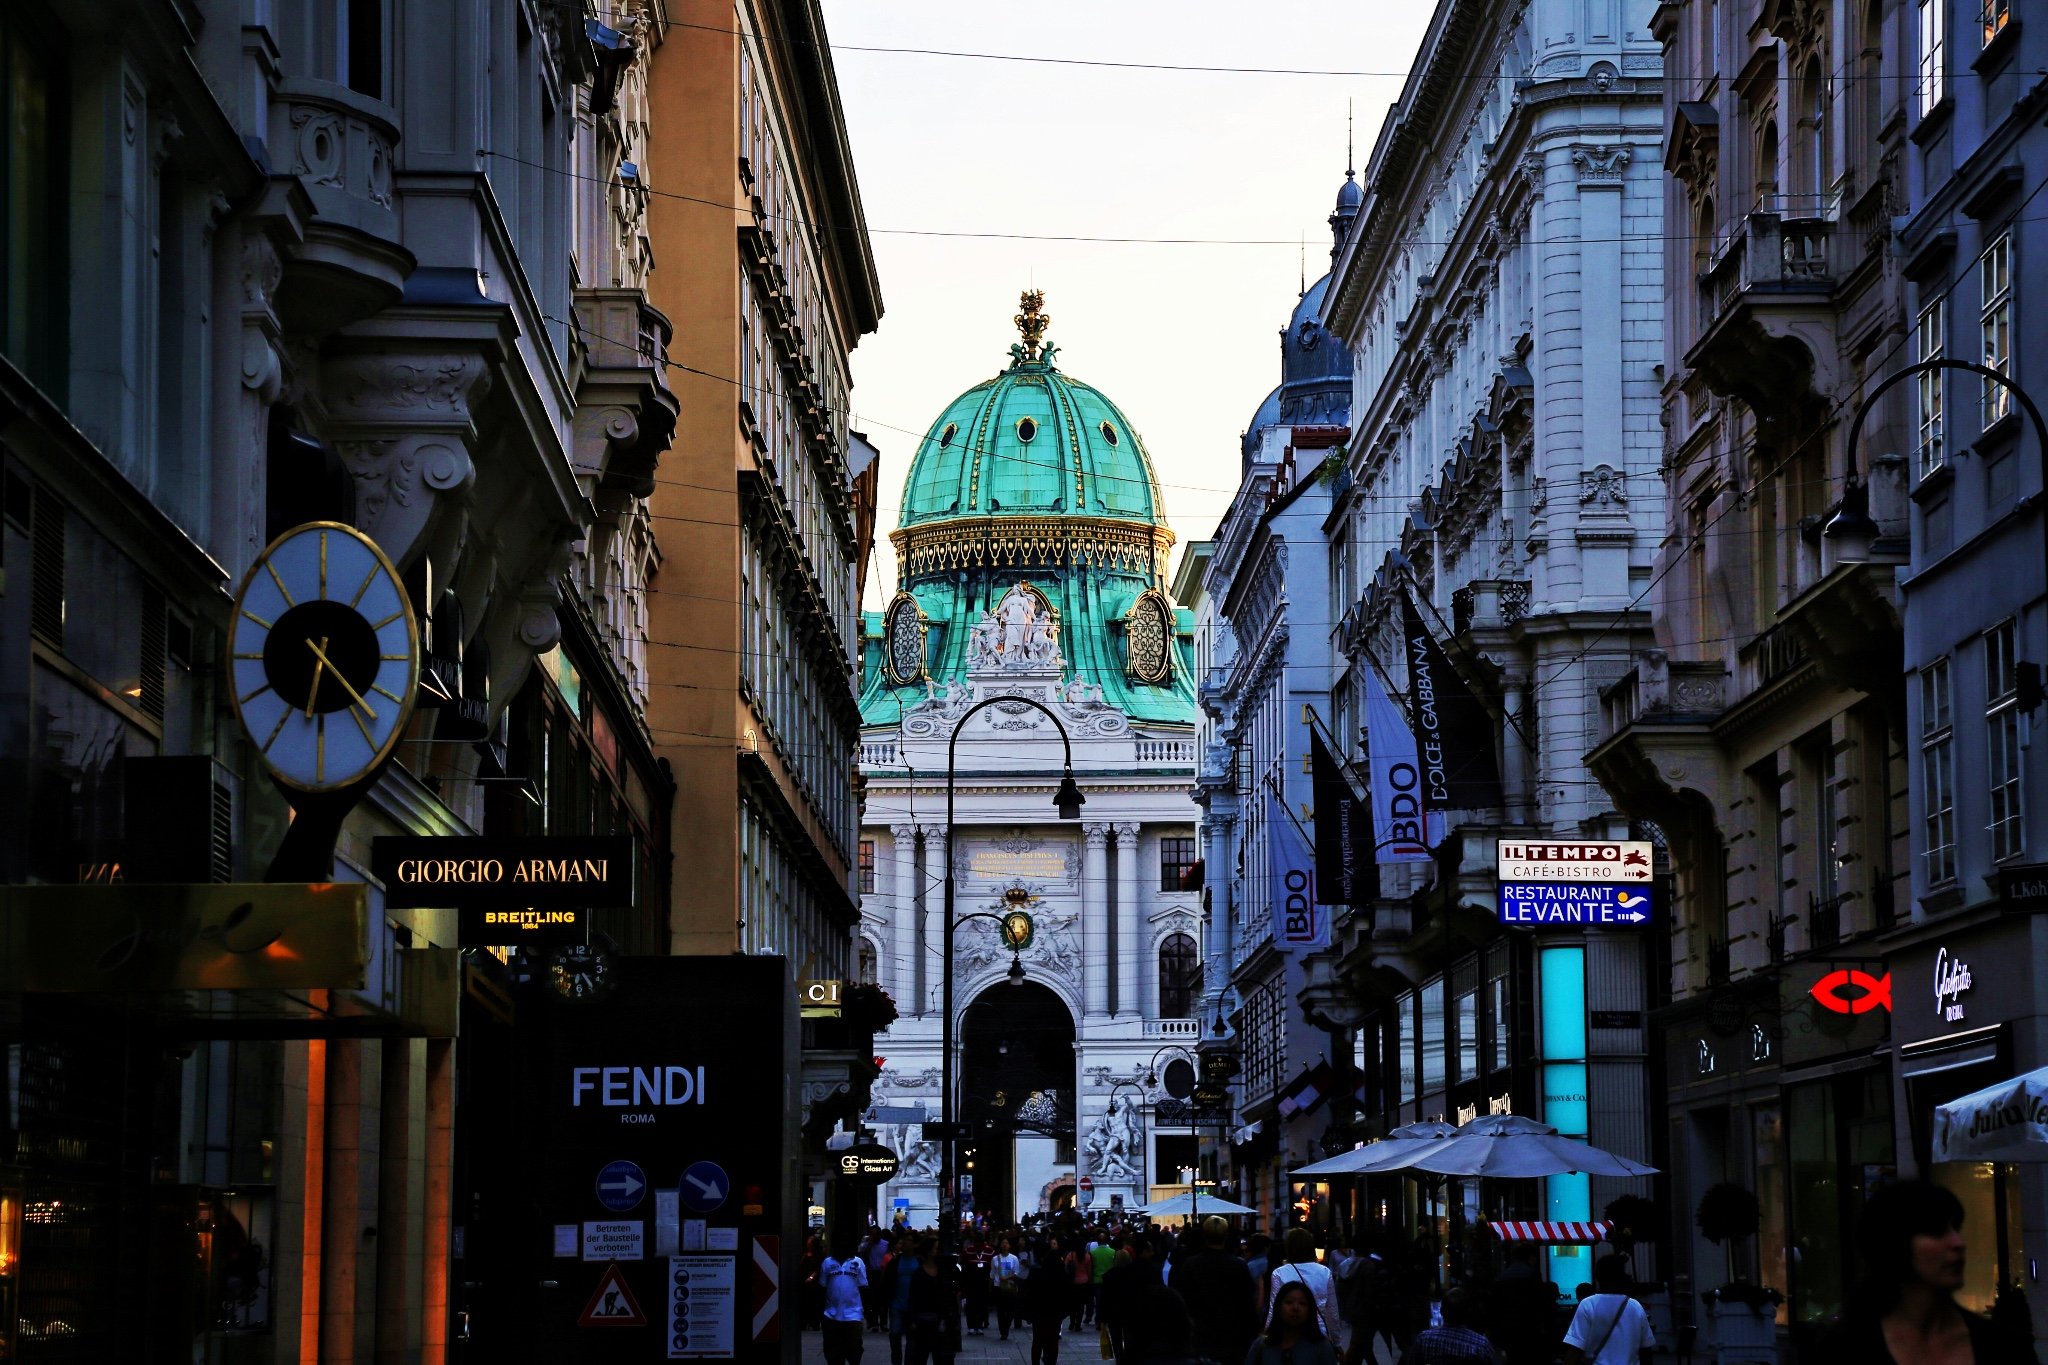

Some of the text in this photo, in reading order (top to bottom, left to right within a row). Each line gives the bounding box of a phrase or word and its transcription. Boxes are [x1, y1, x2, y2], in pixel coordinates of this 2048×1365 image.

[1413, 636, 1448, 801] DOLCE & GABBANA
[1388, 762, 1420, 845] BDO
[1340, 799, 1353, 866] Ermenegildo
[1504, 847, 1617, 860] IL TEMPO
[398, 859, 609, 883] GIORGIO ARMANI
[1504, 886, 1613, 900] RESTAURANT
[2021, 879, 2048, 898] Koh
[1284, 869, 1308, 935] BDO
[485, 908, 576, 924] BREITLING
[1504, 902, 1614, 922] LEVANTE
[521, 922, 539, 930] 1884
[572, 1065, 705, 1107] FENDI
[621, 1113, 656, 1124] ROMA
[1969, 1102, 2026, 1139] Juliu
[841, 1155, 859, 1168] GS
[596, 1224, 631, 1233] Betreten
[586, 1233, 640, 1243] der Baustelle
[593, 1242, 634, 1252] verboten!
